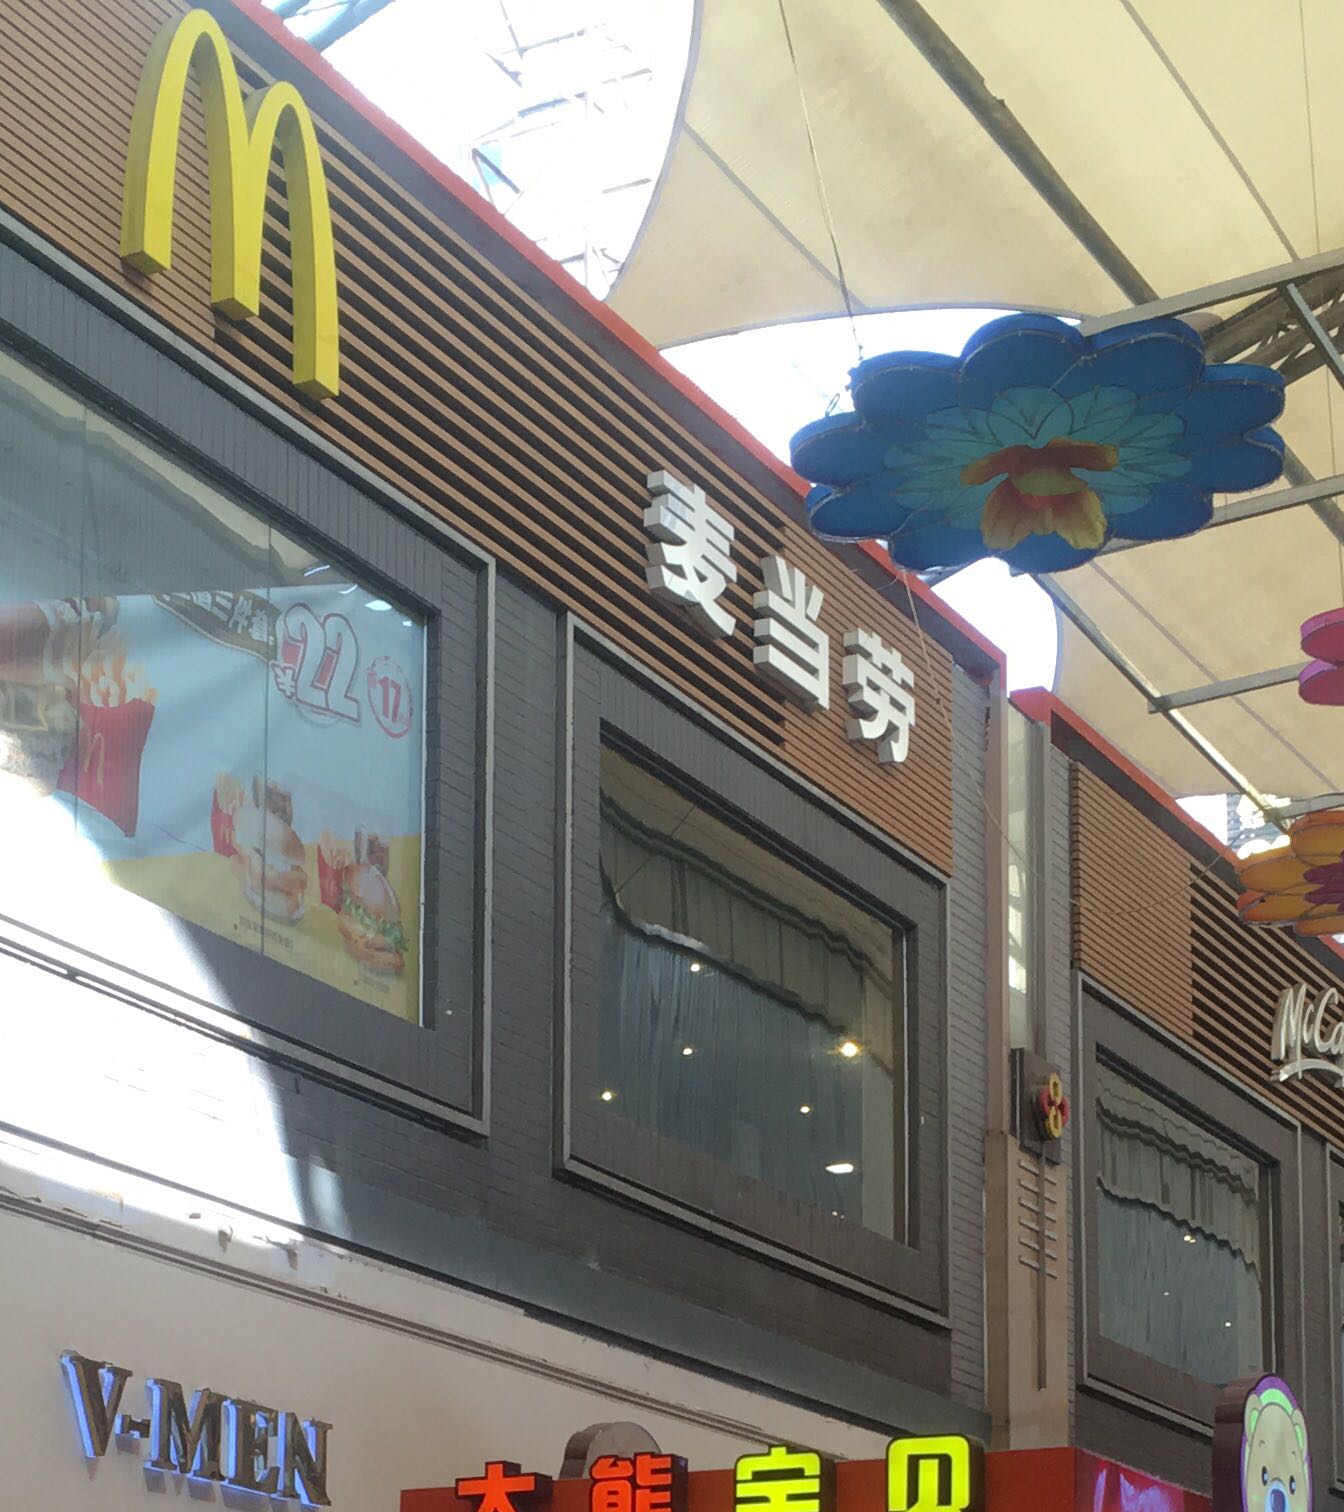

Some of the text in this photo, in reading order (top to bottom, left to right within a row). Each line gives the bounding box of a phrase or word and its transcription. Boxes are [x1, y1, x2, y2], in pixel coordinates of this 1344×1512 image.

[643, 470, 916, 764] 麦当劳
[59, 1350, 335, 1508] V-MEN
